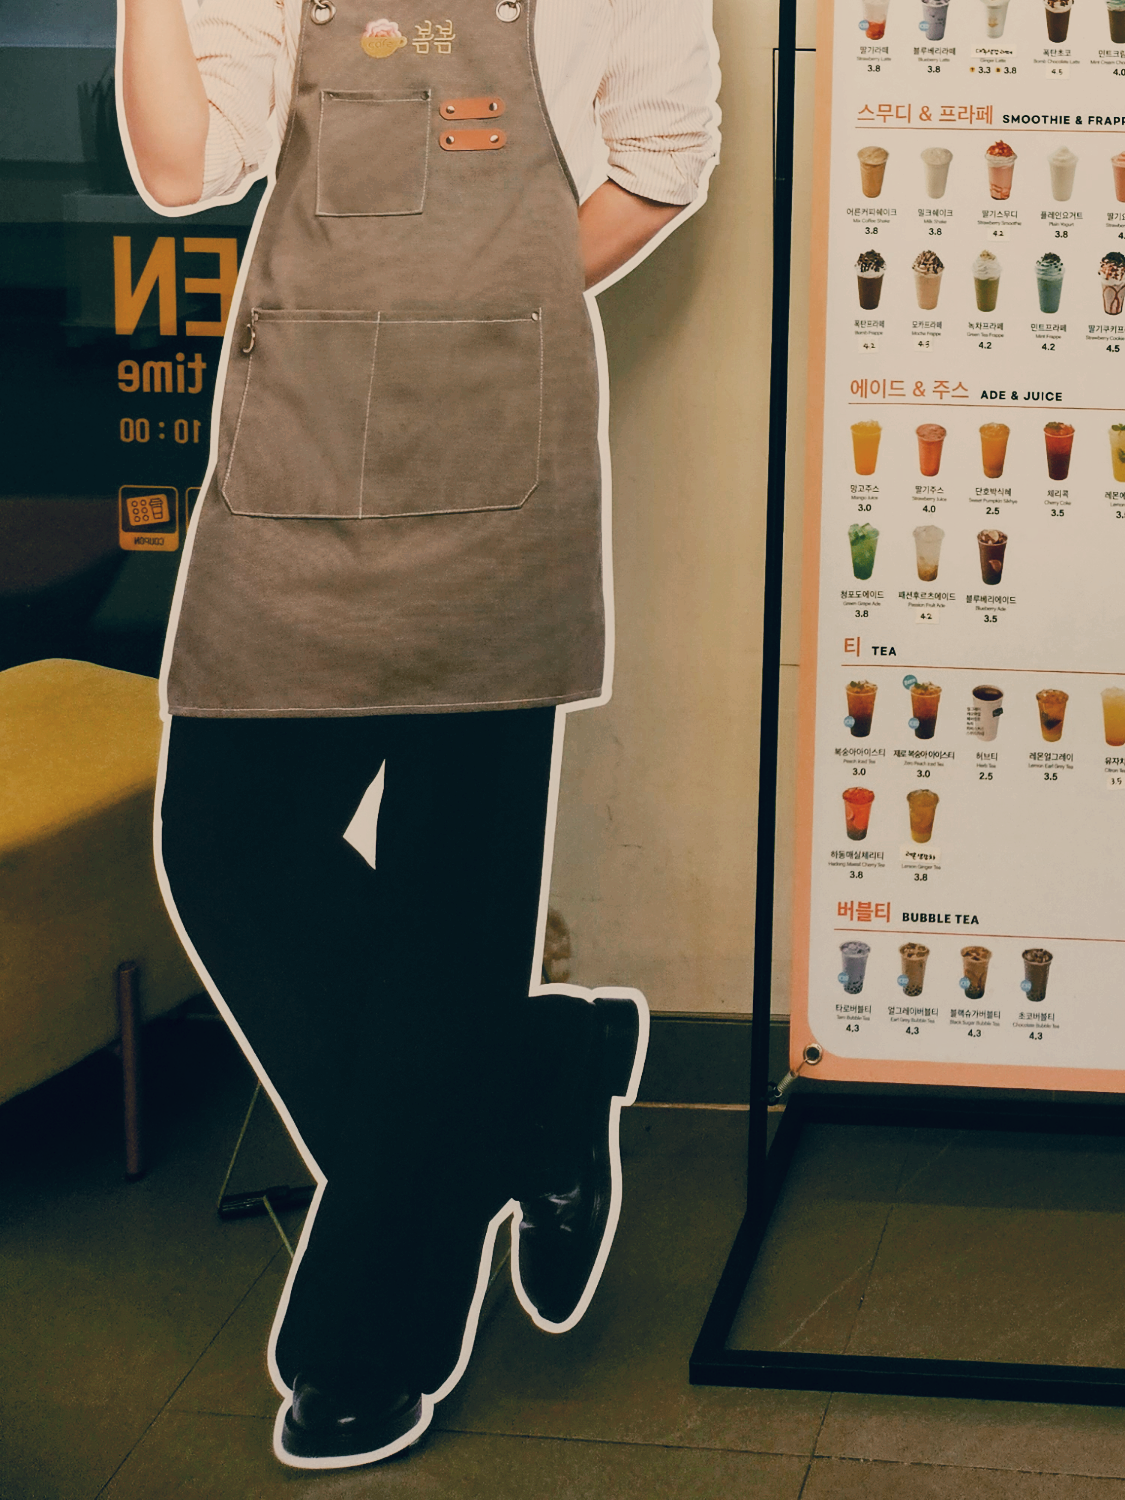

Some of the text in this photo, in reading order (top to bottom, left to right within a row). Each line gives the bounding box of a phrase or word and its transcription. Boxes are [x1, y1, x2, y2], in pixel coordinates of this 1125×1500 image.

[412, 20, 456, 54] 봄봄
[857, 104, 911, 124] 스무디
[919, 105, 932, 122] &
[939, 105, 993, 125] 프라페
[1002, 114, 1070, 125] SMOOTHIE
[1075, 116, 1083, 125] &
[850, 379, 1062, 402] 에이드 & 주스 ADE & JUICE
[844, 636, 896, 657] 티 TEA
[837, 900, 980, 924] 버블티 BUBBLE TEA
[836, 1004, 872, 1014] 타로버블티
[846, 1023, 860, 1032] 4.3
